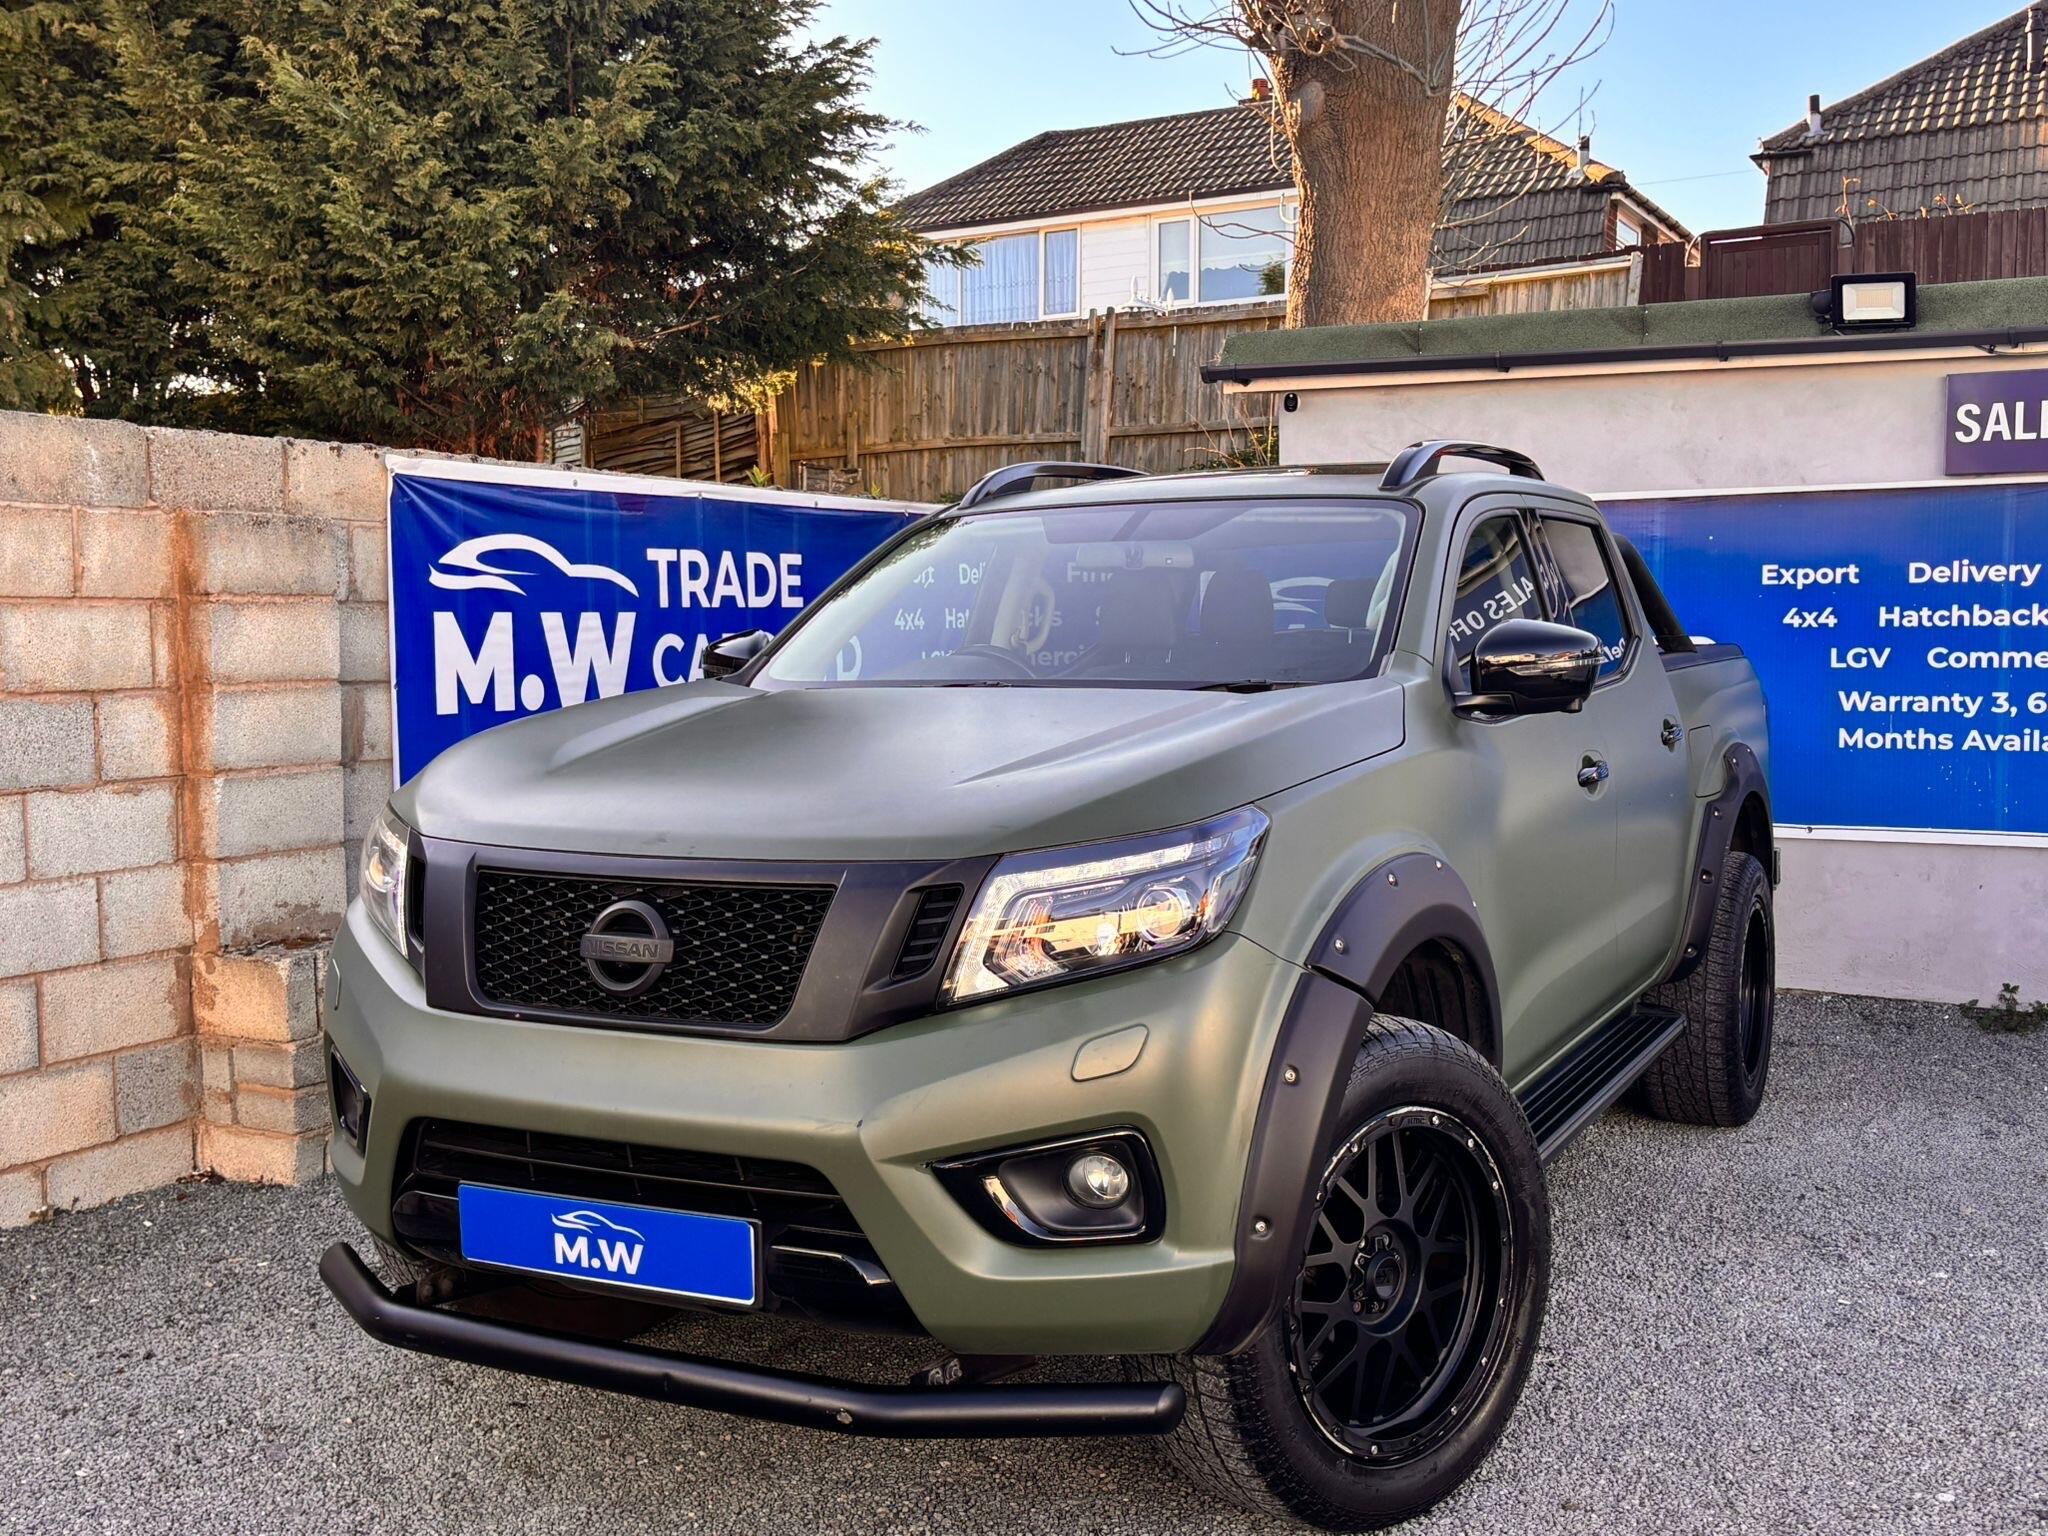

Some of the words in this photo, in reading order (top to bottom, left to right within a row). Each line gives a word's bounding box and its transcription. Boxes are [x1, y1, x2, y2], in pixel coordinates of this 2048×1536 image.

[646, 548, 804, 608] TRADE
[1761, 563, 1860, 589] Export
[1908, 559, 2042, 587] Delivery
[1782, 607, 1839, 629] 4x4
[433, 612, 637, 716] M.W
[1830, 647, 1891, 669] LGV
[1838, 691, 1984, 718] Warranty
[1990, 692, 2018, 718] 3,
[2026, 692, 2048, 714] 6
[1838, 727, 1954, 751] Months
[584, 938, 659, 959] NISSAN
[553, 1232, 645, 1275] M.W
